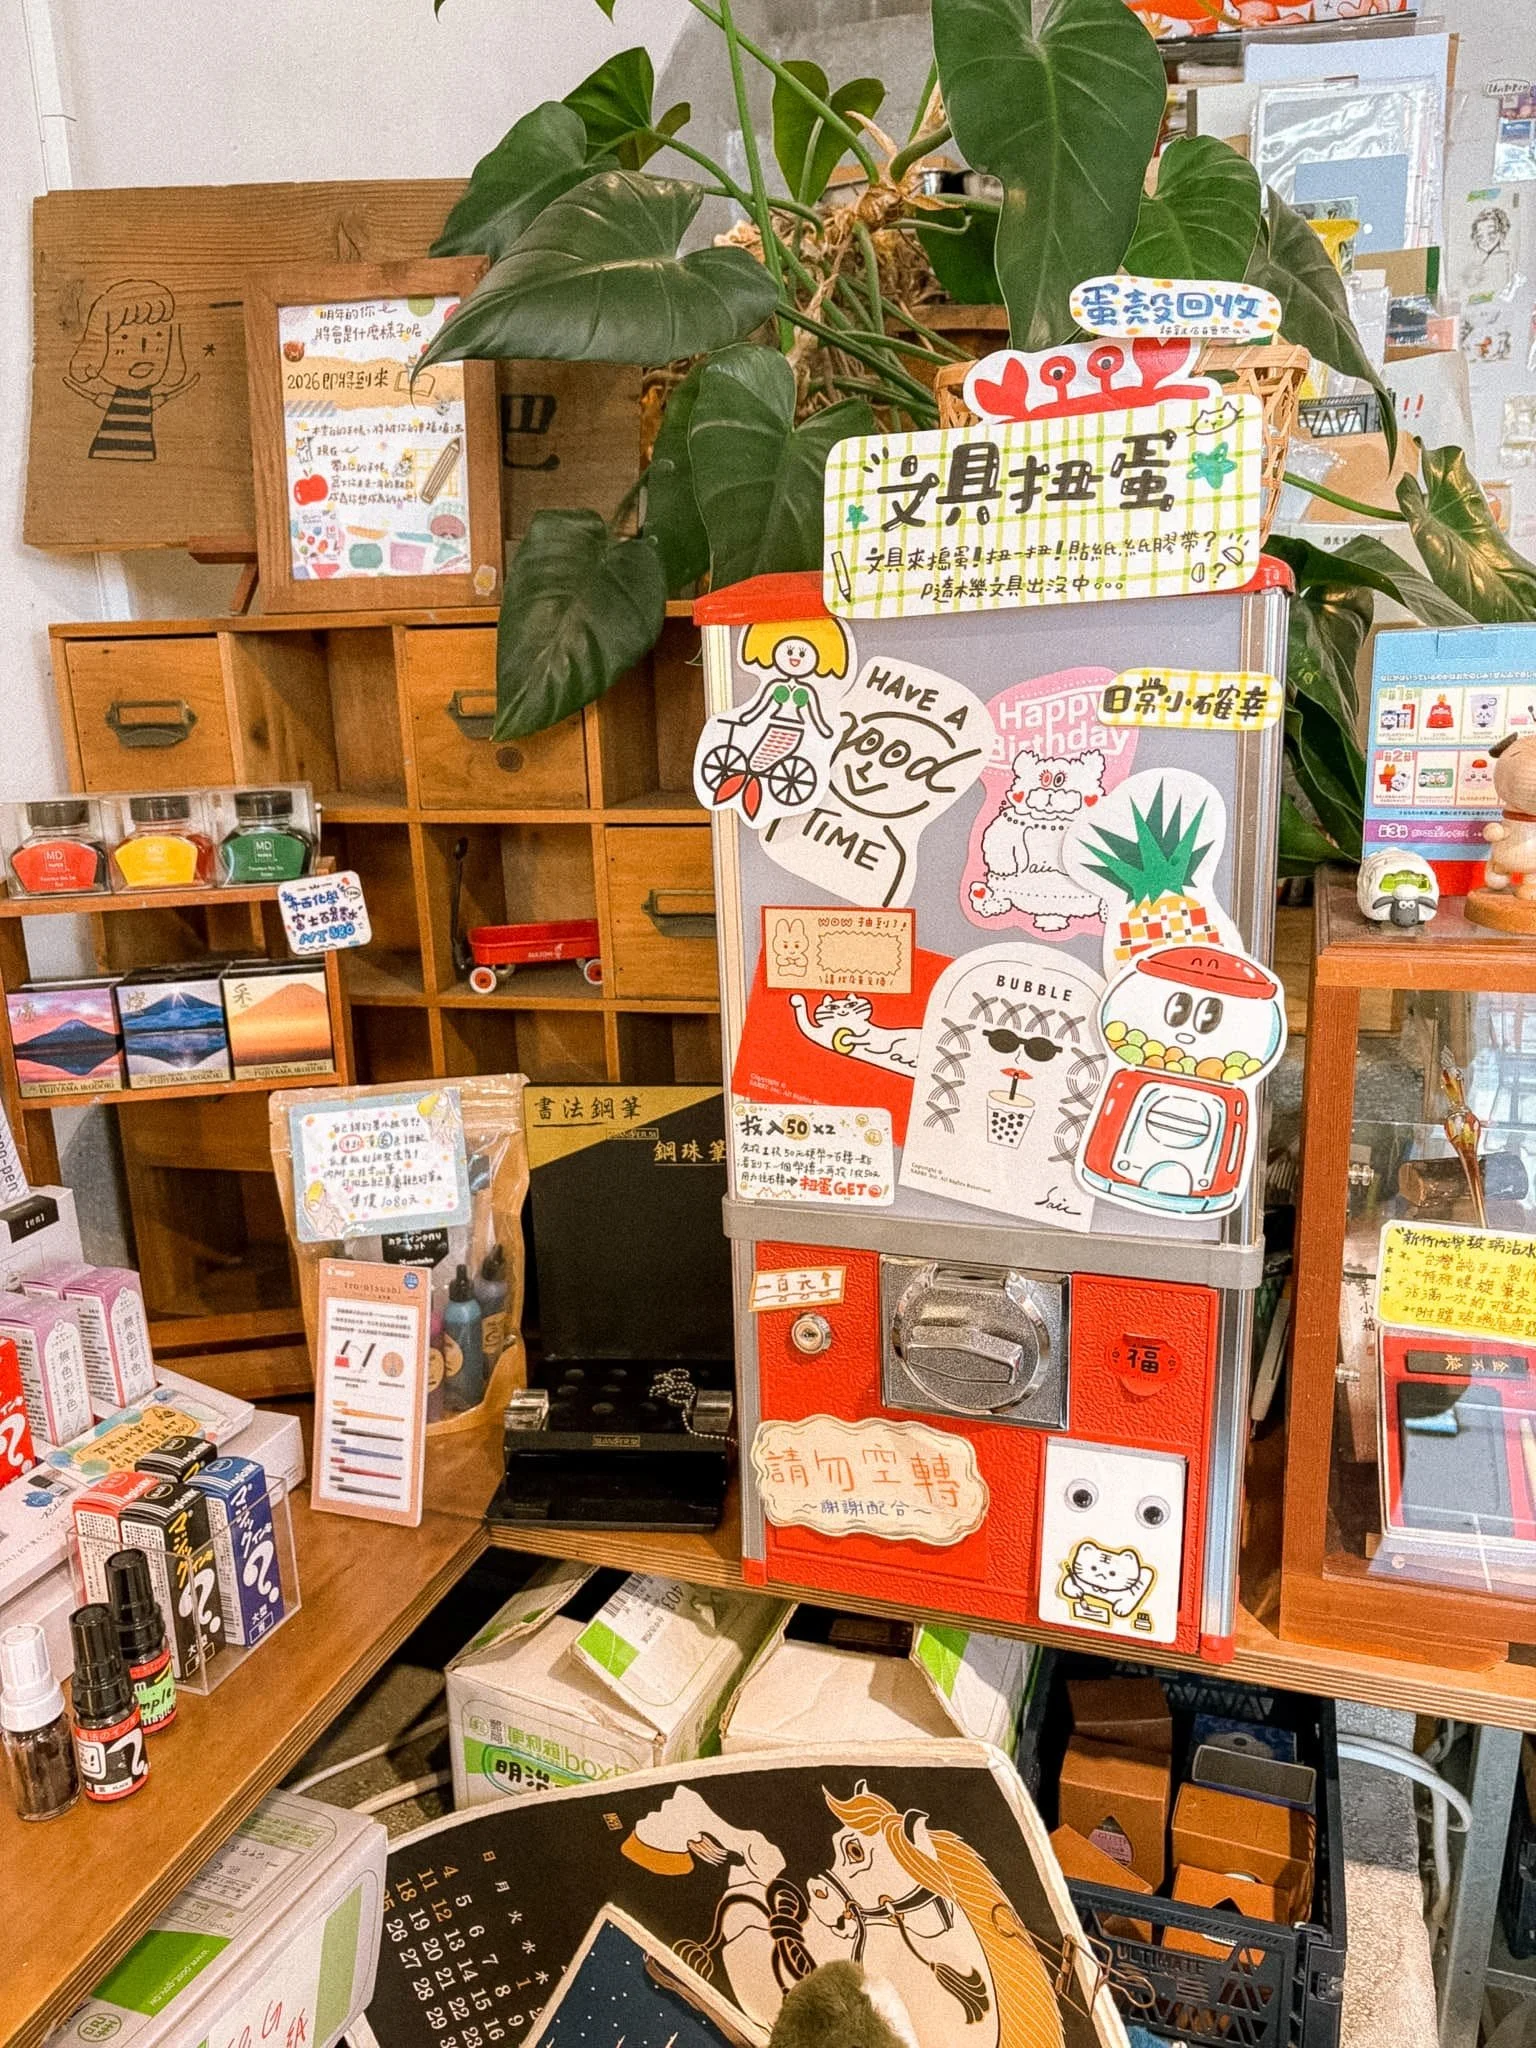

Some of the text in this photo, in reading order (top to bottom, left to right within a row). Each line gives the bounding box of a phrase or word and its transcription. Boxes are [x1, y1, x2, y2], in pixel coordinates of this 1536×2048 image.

[1081, 283, 1263, 327] 蛋殼回收
[287, 369, 389, 390] 2026即將到來
[877, 428, 1177, 534] 文具扭蛋
[866, 665, 971, 733] HAVE A
[1102, 677, 1268, 721] 日常小確幸
[46, 850, 63, 860] MD
[255, 841, 272, 850] MD
[801, 806, 889, 872] TIME
[818, 917, 853, 928] WOW
[996, 975, 1073, 1002] BUBBLE
[534, 1095, 643, 1120] 書法鋼筆
[653, 1139, 726, 1162] 鋼珠筆
[757, 1274, 816, 1292] 一百元
[1127, 1344, 1160, 1374] 福
[764, 1443, 961, 1508] 請勿空轉
[820, 1499, 910, 1518] 謝謝配合
[140, 1688, 172, 1714] mple
[508, 1726, 560, 1760] 便利箱
[417, 1868, 506, 2041] 11 12 13 14 15 16
[443, 1865, 525, 2027] 4 5 6 7 8 9
[385, 1918, 409, 1943] 26
[399, 1948, 423, 1970] 27
[411, 1977, 434, 2001] 28
[425, 2006, 448, 2030] 29
[395, 1878, 484, 2048] 18 19 20 21 22 23
